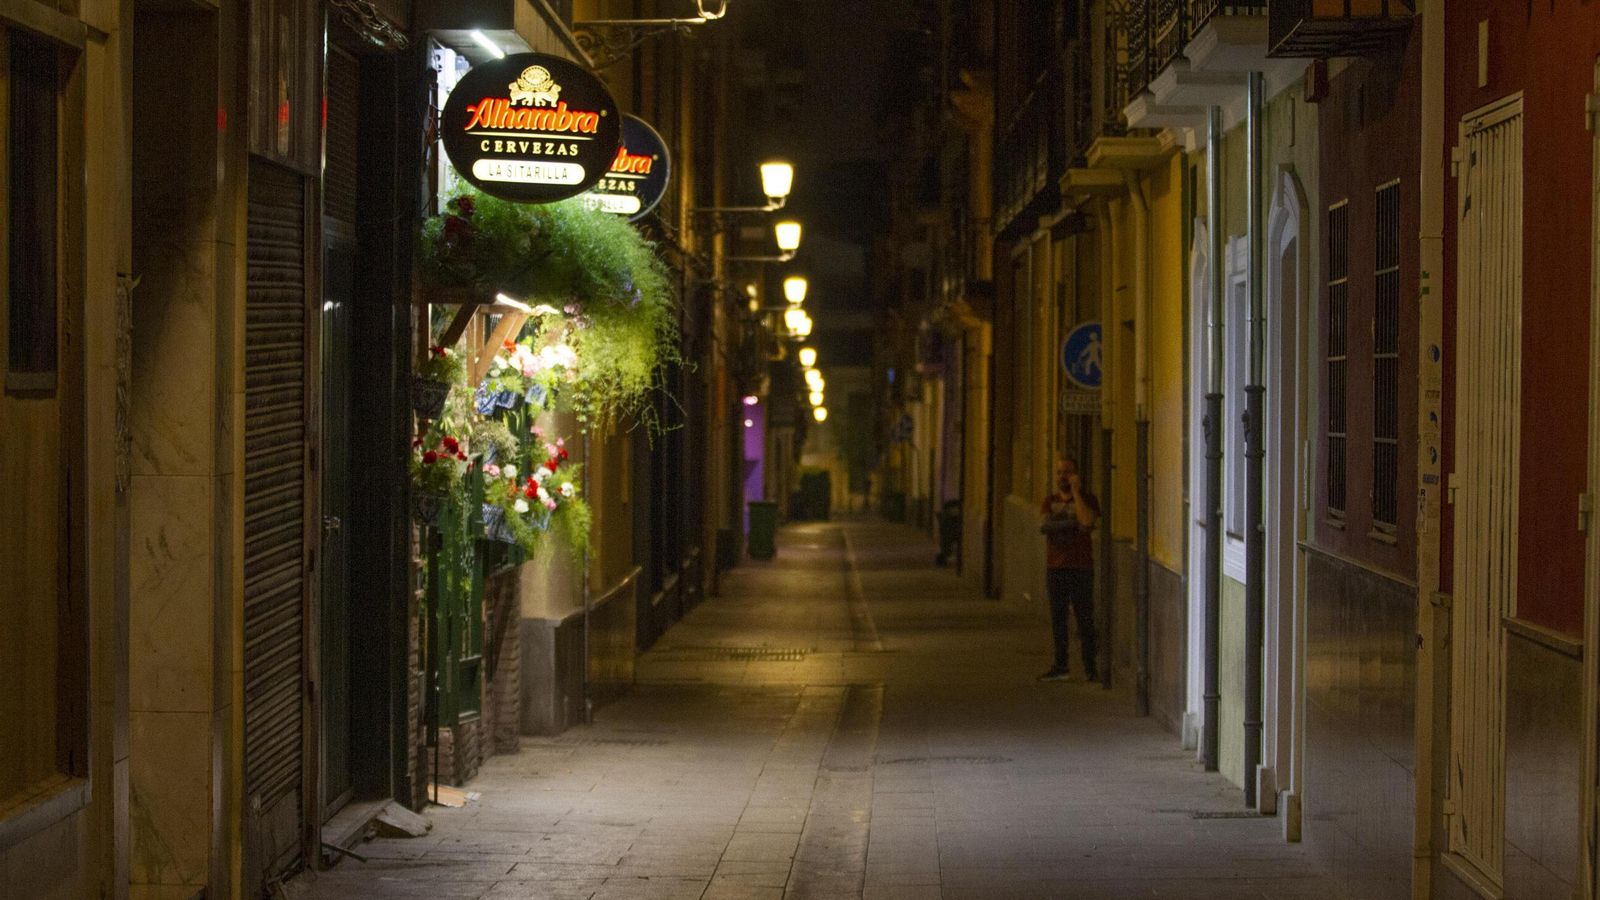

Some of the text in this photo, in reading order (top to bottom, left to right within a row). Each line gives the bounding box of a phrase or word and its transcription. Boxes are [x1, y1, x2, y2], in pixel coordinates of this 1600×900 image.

[464, 97, 600, 135] Alhambra
[480, 140, 579, 157] CERVEZAS
[489, 163, 568, 180] LA SITARILLA
[609, 146, 653, 175] bra
